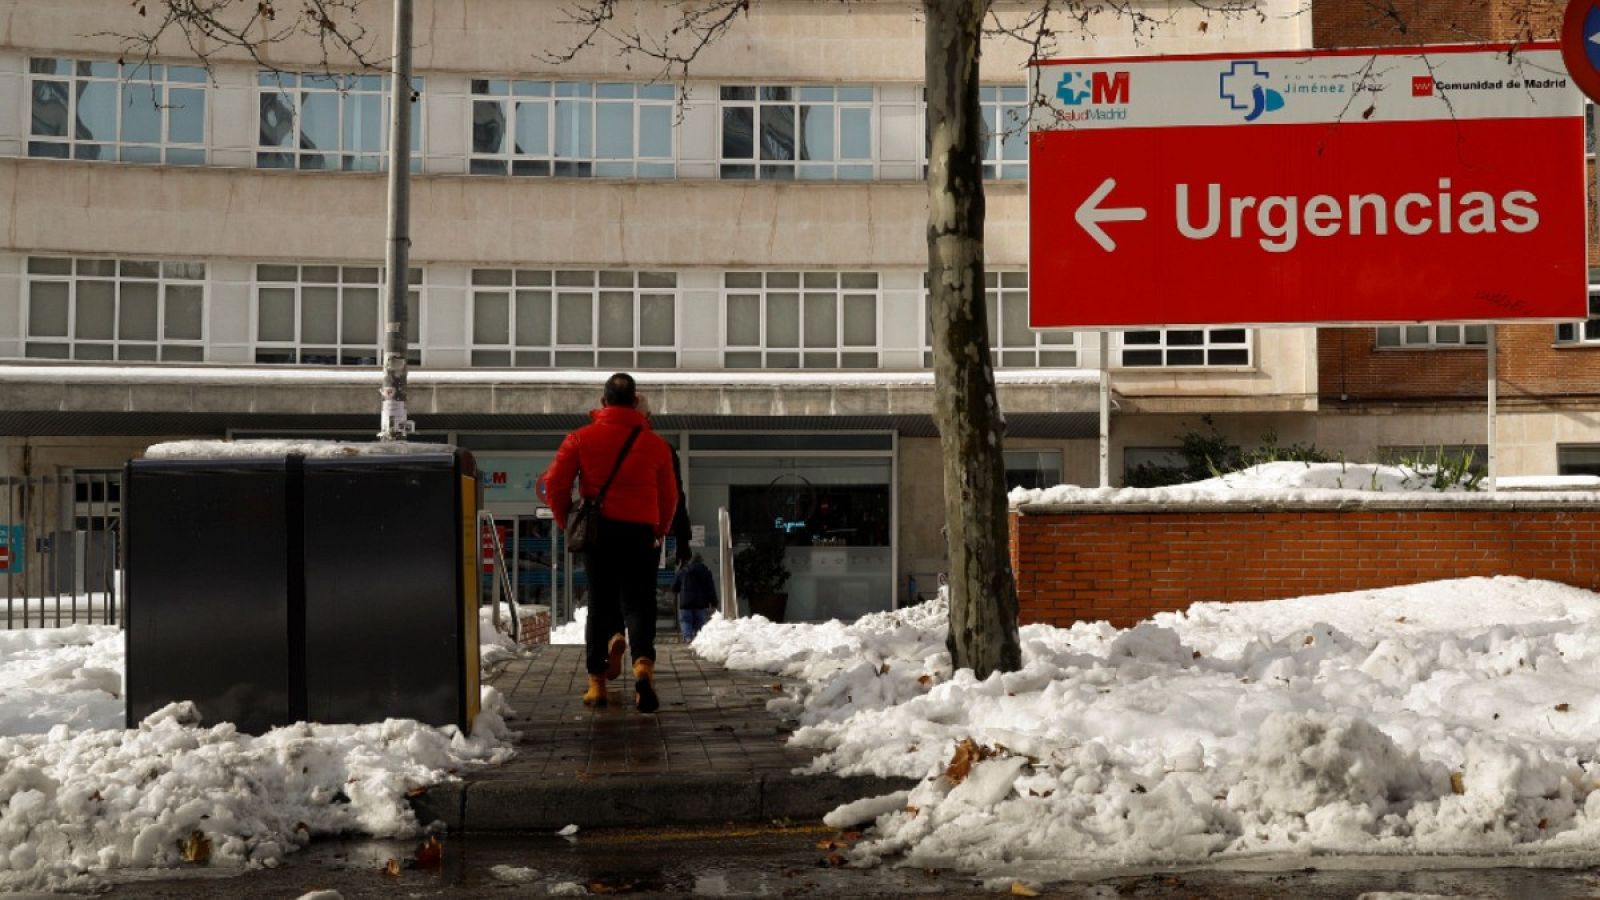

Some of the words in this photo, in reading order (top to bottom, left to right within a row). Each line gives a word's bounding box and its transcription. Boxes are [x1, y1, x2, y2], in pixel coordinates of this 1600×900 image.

[1091, 71, 1130, 105] M
[1284, 82, 1345, 93] Jiménez
[1435, 80, 1502, 90] Comunidad
[1506, 79, 1521, 89] de
[1524, 79, 1567, 89] Madrid
[1175, 177, 1541, 252] Urgencias
